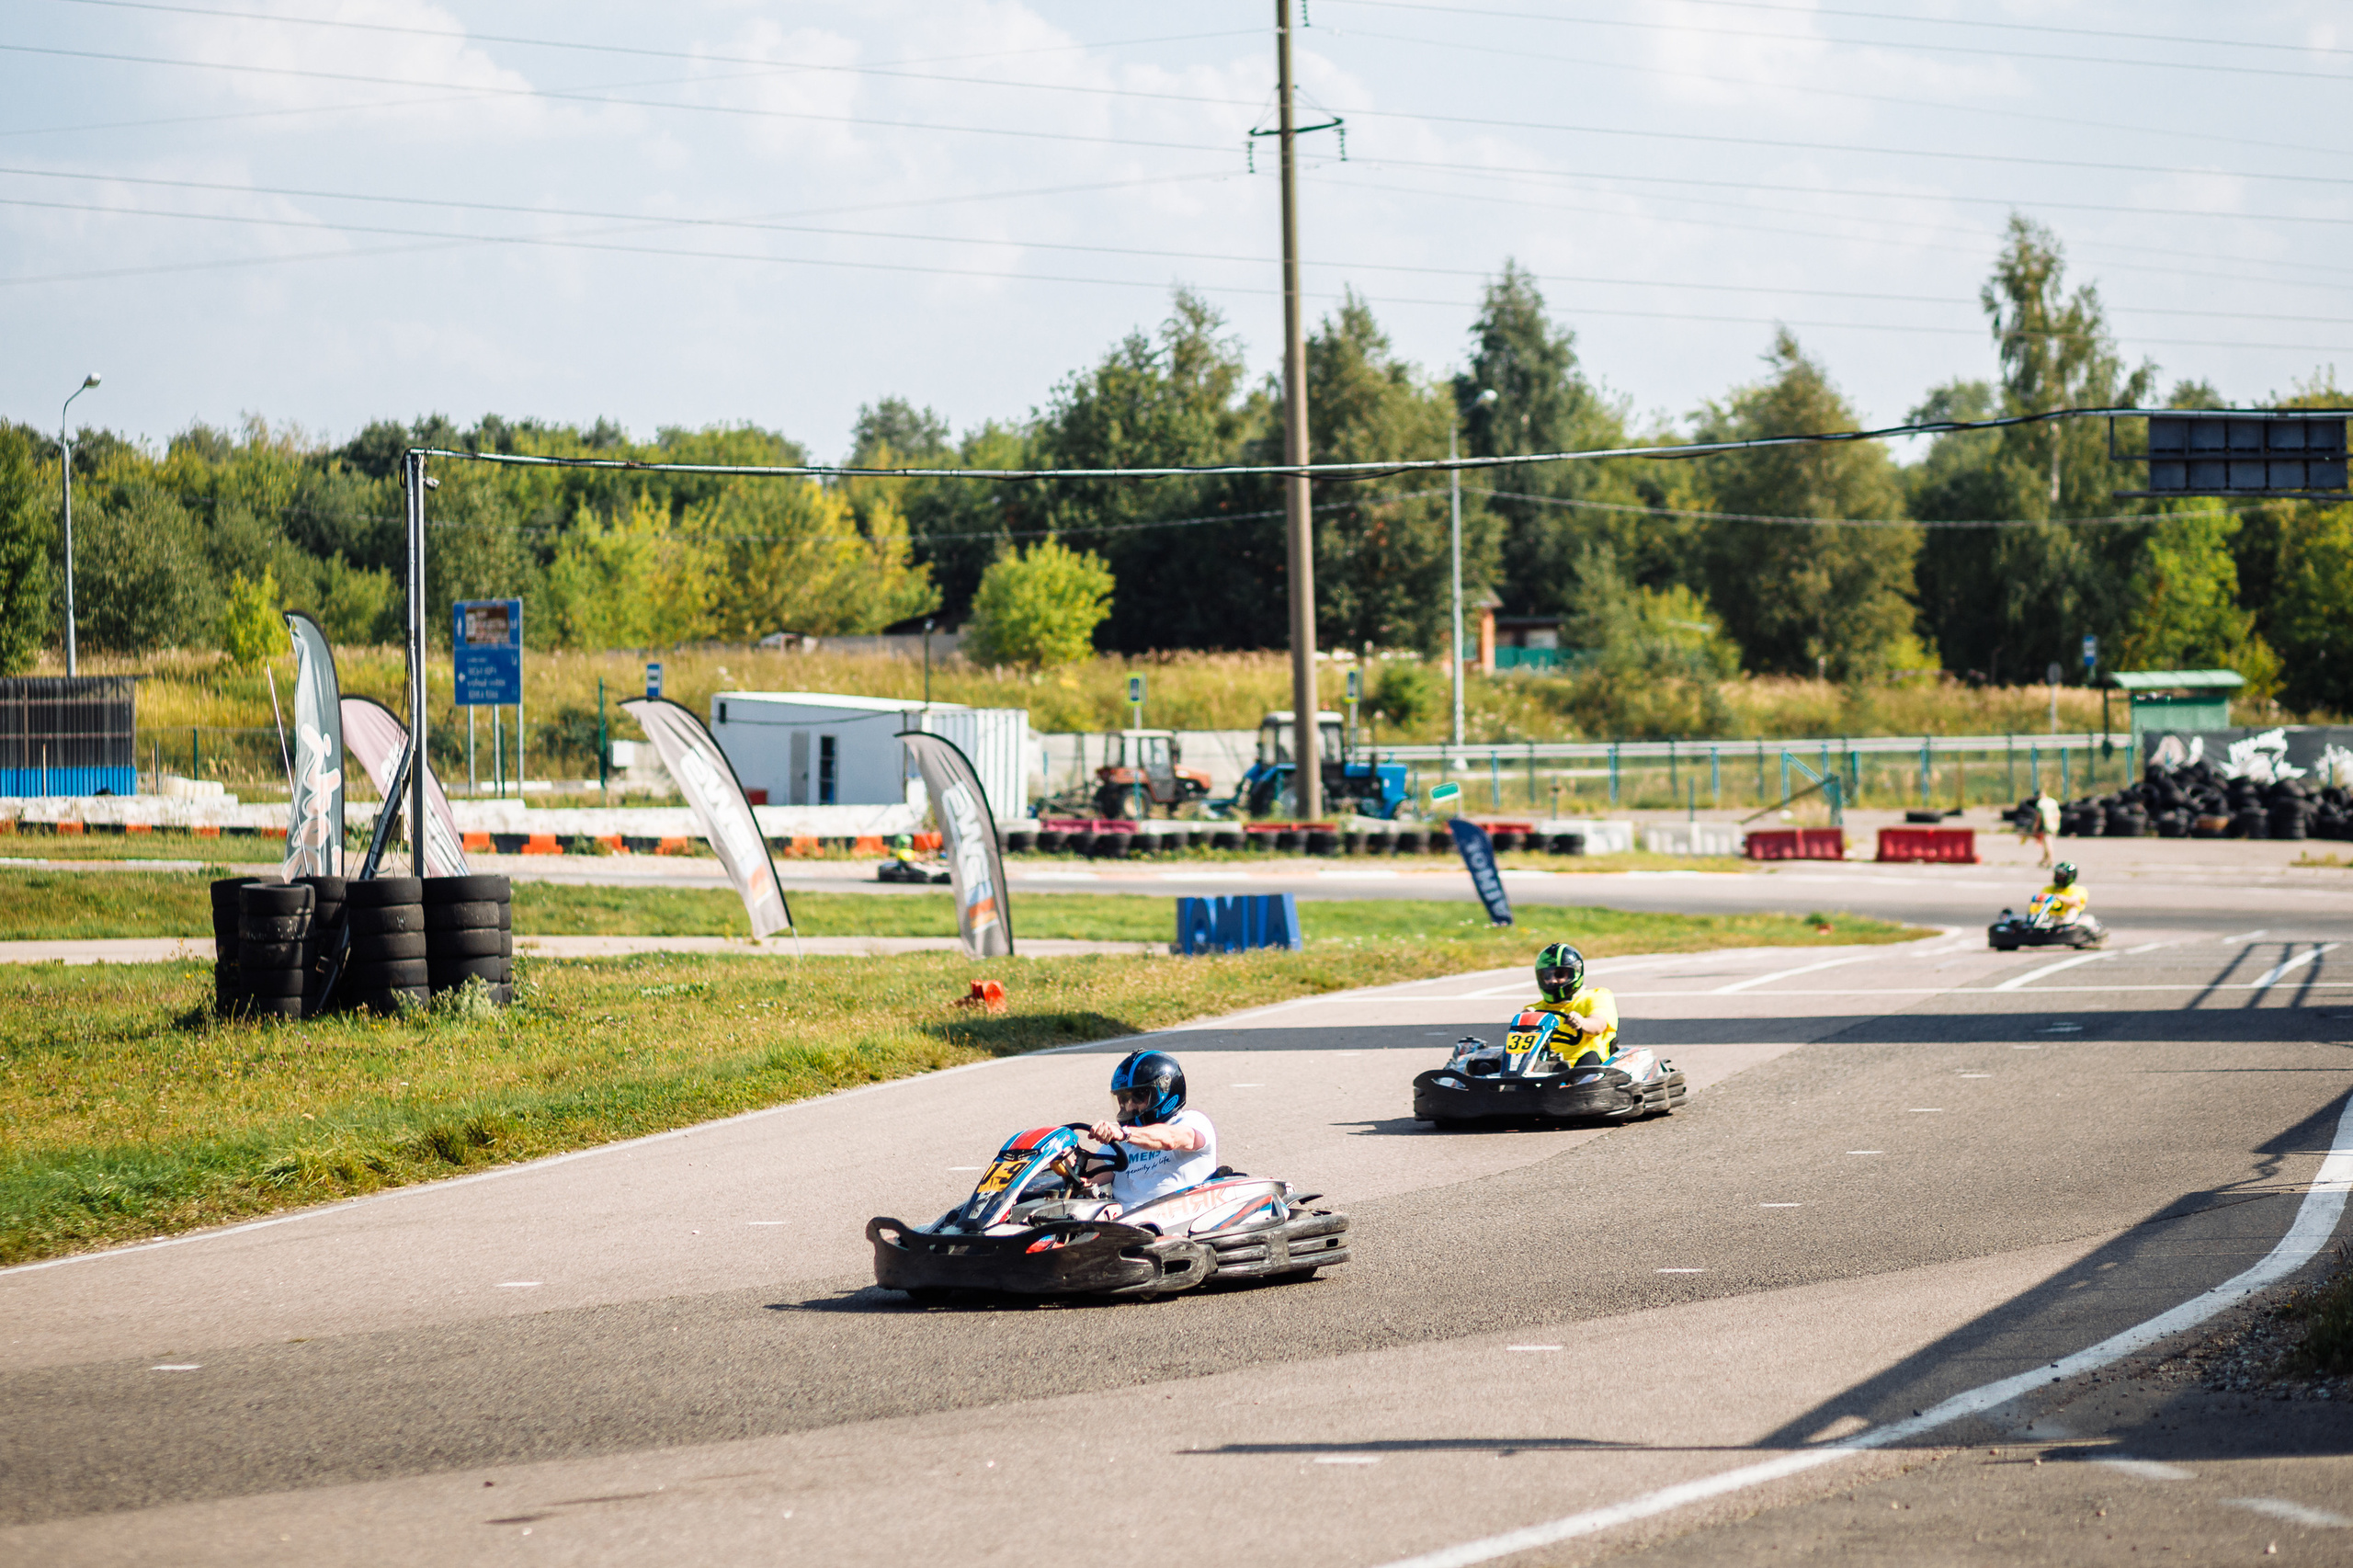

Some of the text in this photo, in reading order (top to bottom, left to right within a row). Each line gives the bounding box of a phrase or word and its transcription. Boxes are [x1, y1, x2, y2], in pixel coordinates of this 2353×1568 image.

[1507, 1035, 1536, 1051] 39
[1129, 1150, 1162, 1165] MENS
[1125, 1164, 1151, 1179] genuity
[1158, 1155, 1172, 1165] life
